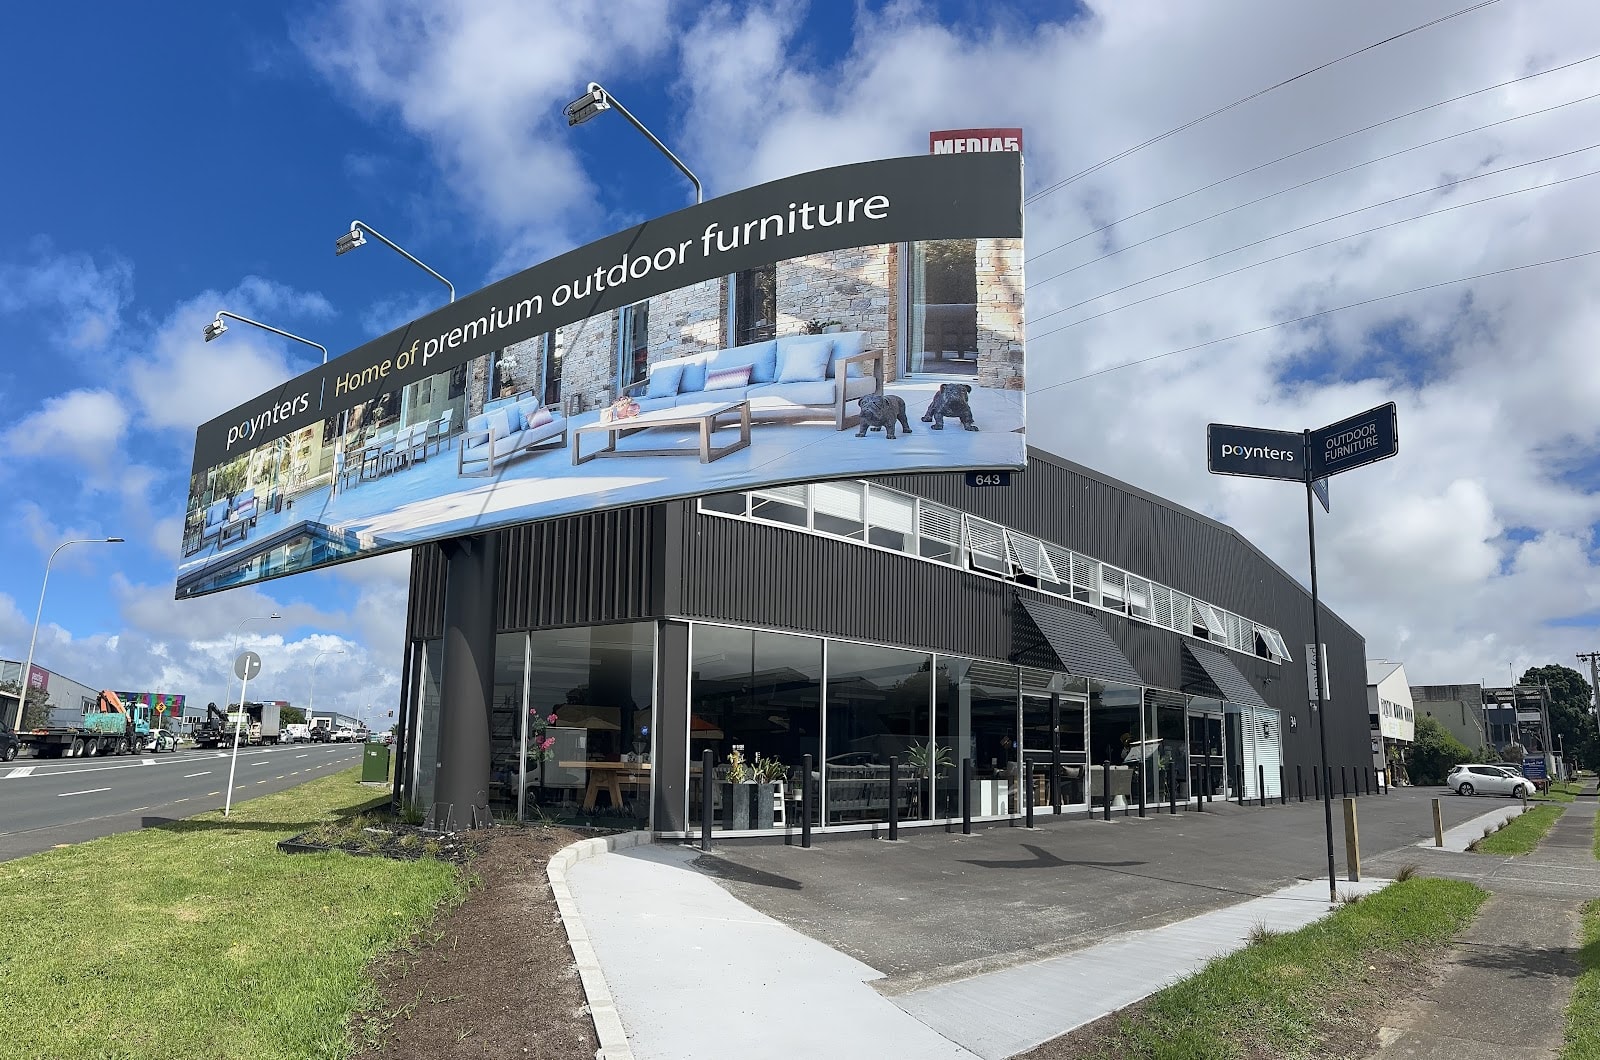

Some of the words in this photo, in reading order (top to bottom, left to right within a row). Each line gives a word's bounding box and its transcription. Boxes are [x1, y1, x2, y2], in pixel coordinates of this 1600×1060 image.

[934, 137, 1019, 155] MEDIA5
[226, 391, 309, 451] poynters
[335, 359, 392, 398] Home
[396, 339, 420, 370] of
[422, 294, 543, 366] premium
[551, 239, 693, 307] outdoor
[701, 195, 890, 257] furniture
[1326, 423, 1376, 450] OUTDOOR
[1221, 443, 1294, 461] poynters
[1325, 435, 1379, 462] FURNITURE
[975, 474, 1001, 486] 643
